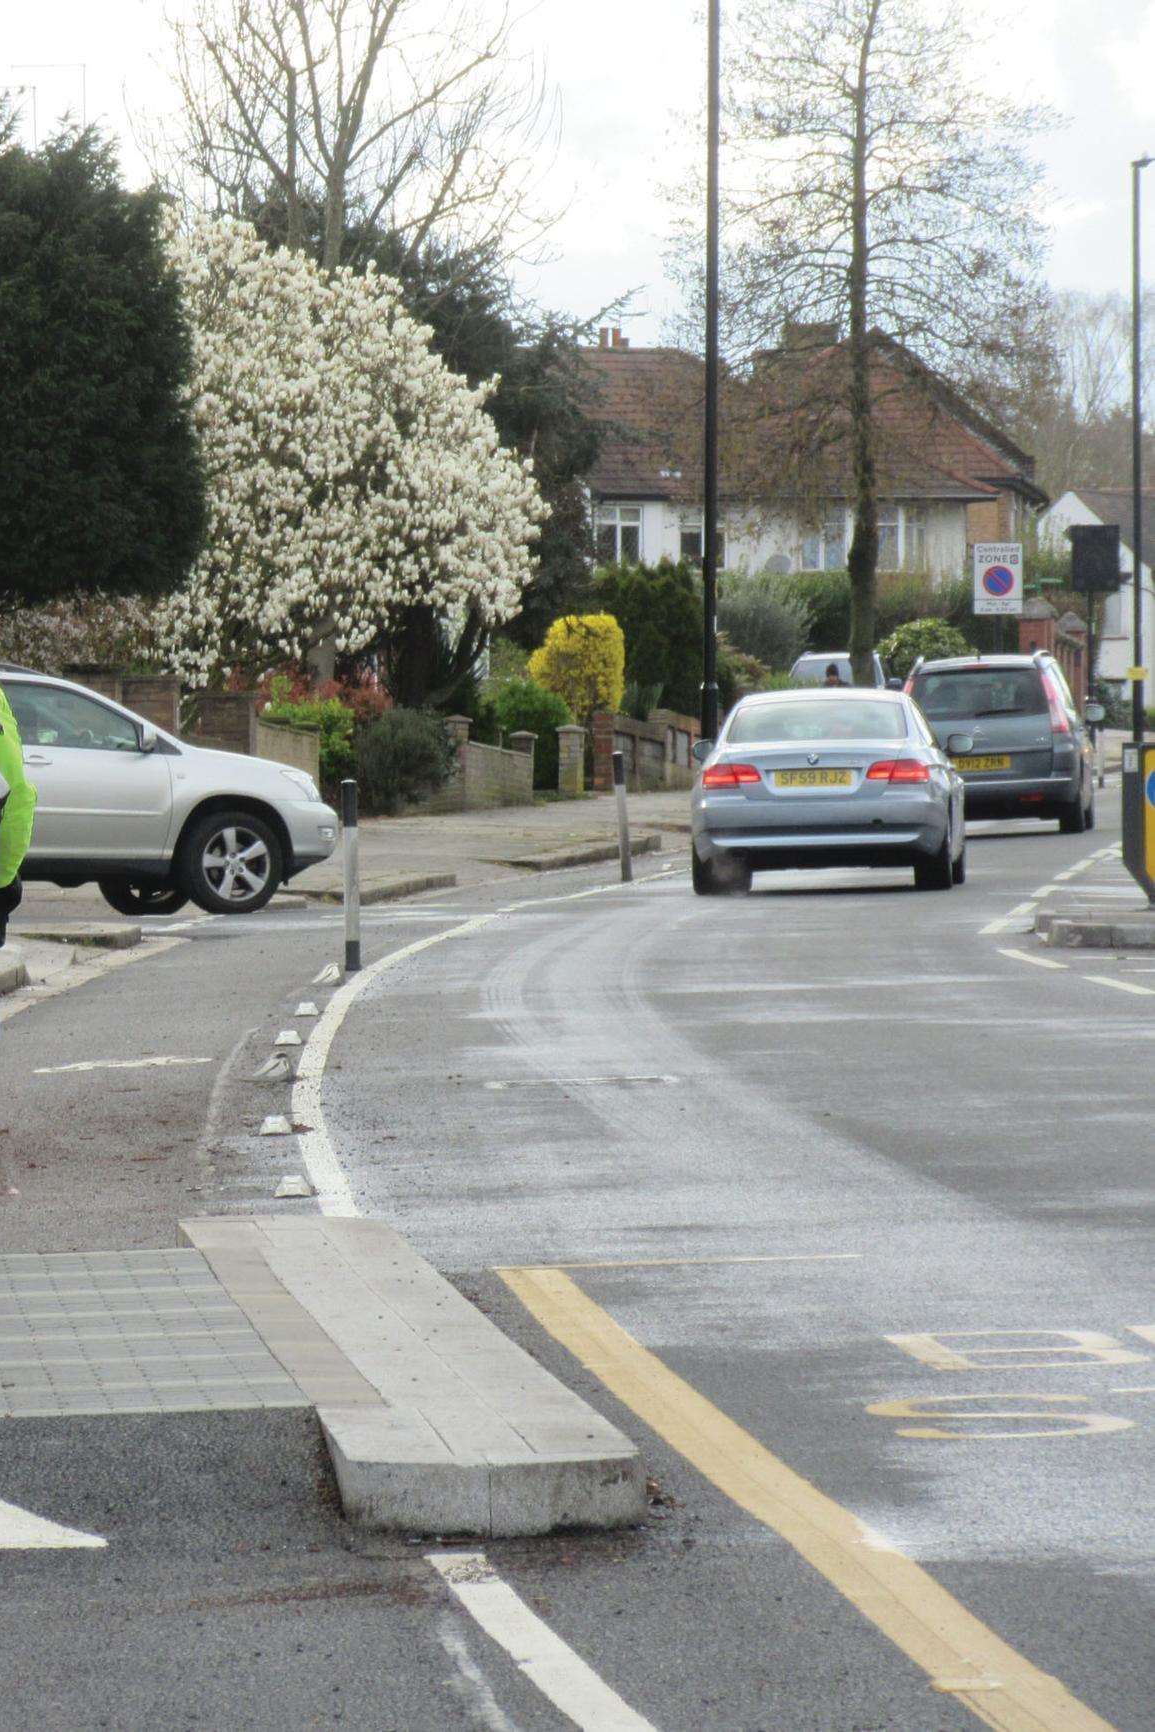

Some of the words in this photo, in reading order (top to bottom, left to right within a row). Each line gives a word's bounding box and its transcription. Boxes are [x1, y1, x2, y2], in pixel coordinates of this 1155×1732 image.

[978, 554, 1008, 563] ZONE
[820, 770, 847, 784] RJZ
[883, 1325, 1155, 1372] B
[864, 1387, 1155, 1440] S
